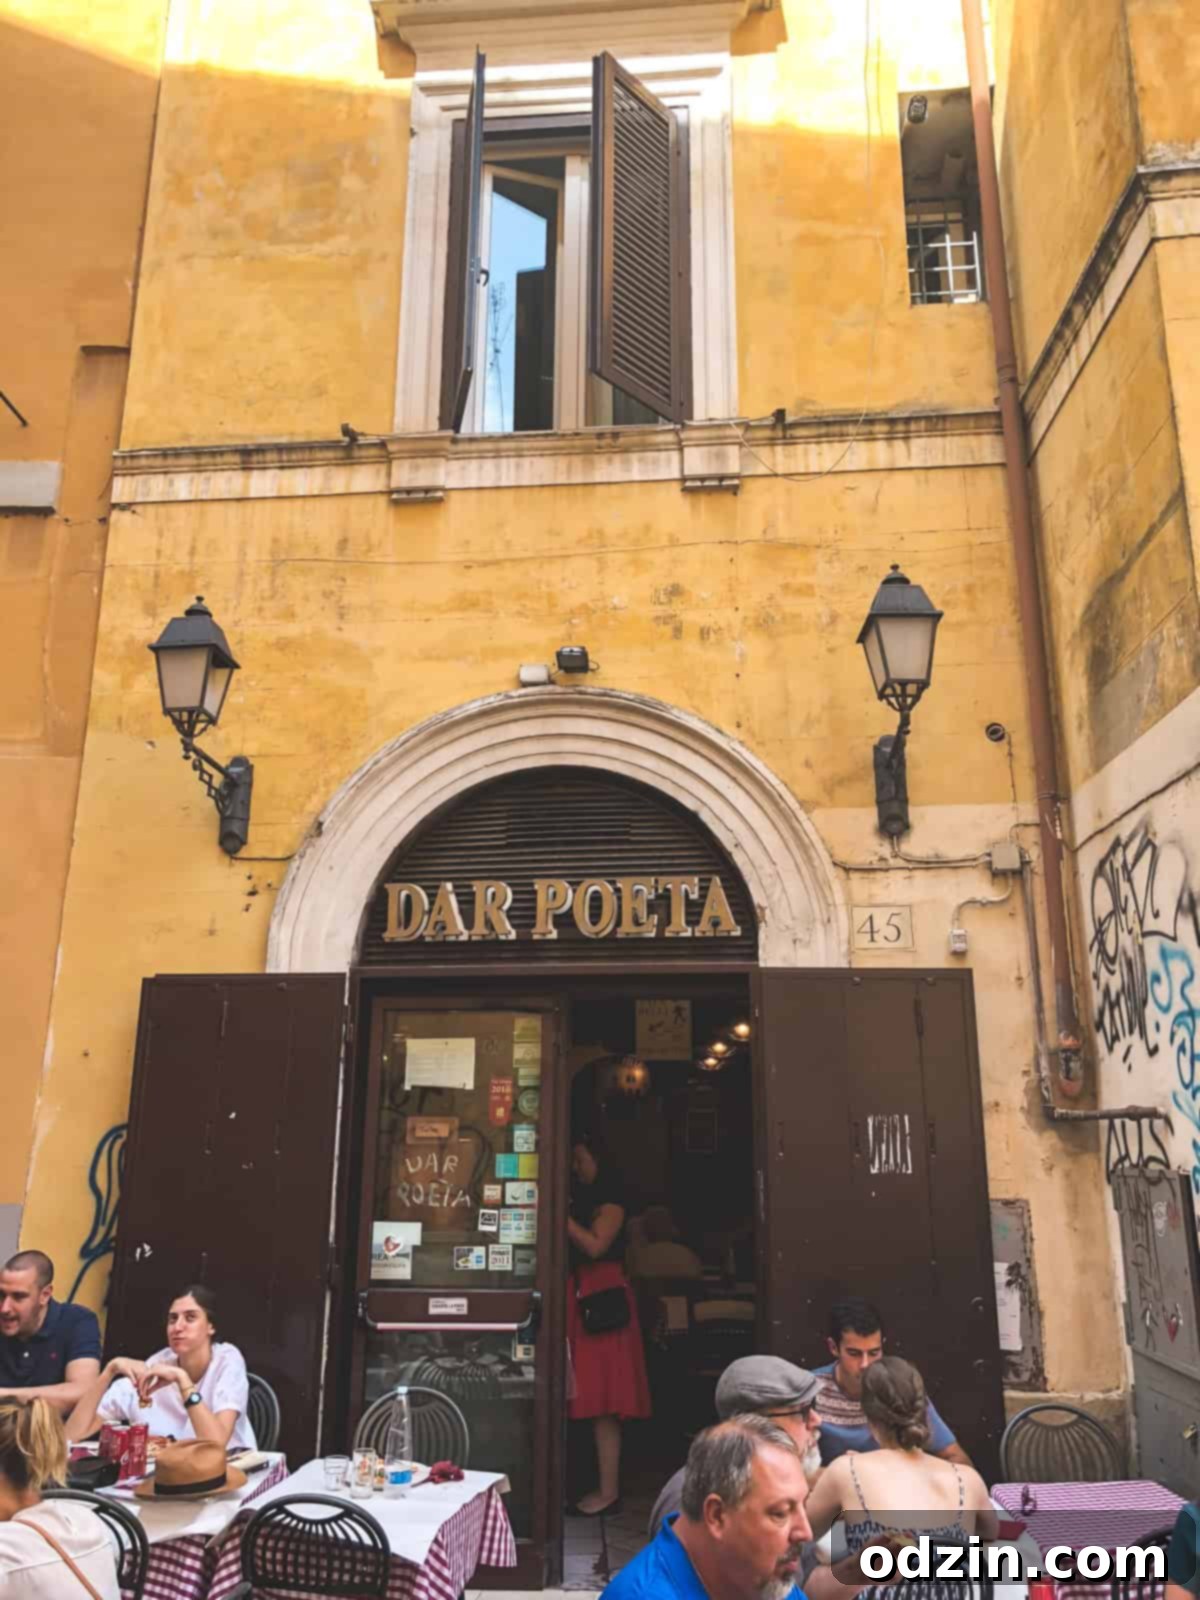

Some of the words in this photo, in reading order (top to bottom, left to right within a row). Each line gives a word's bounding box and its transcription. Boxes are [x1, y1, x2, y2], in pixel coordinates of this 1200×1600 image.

[383, 881, 516, 942] DAR
[532, 876, 741, 940] POETA
[856, 911, 902, 943] 45
